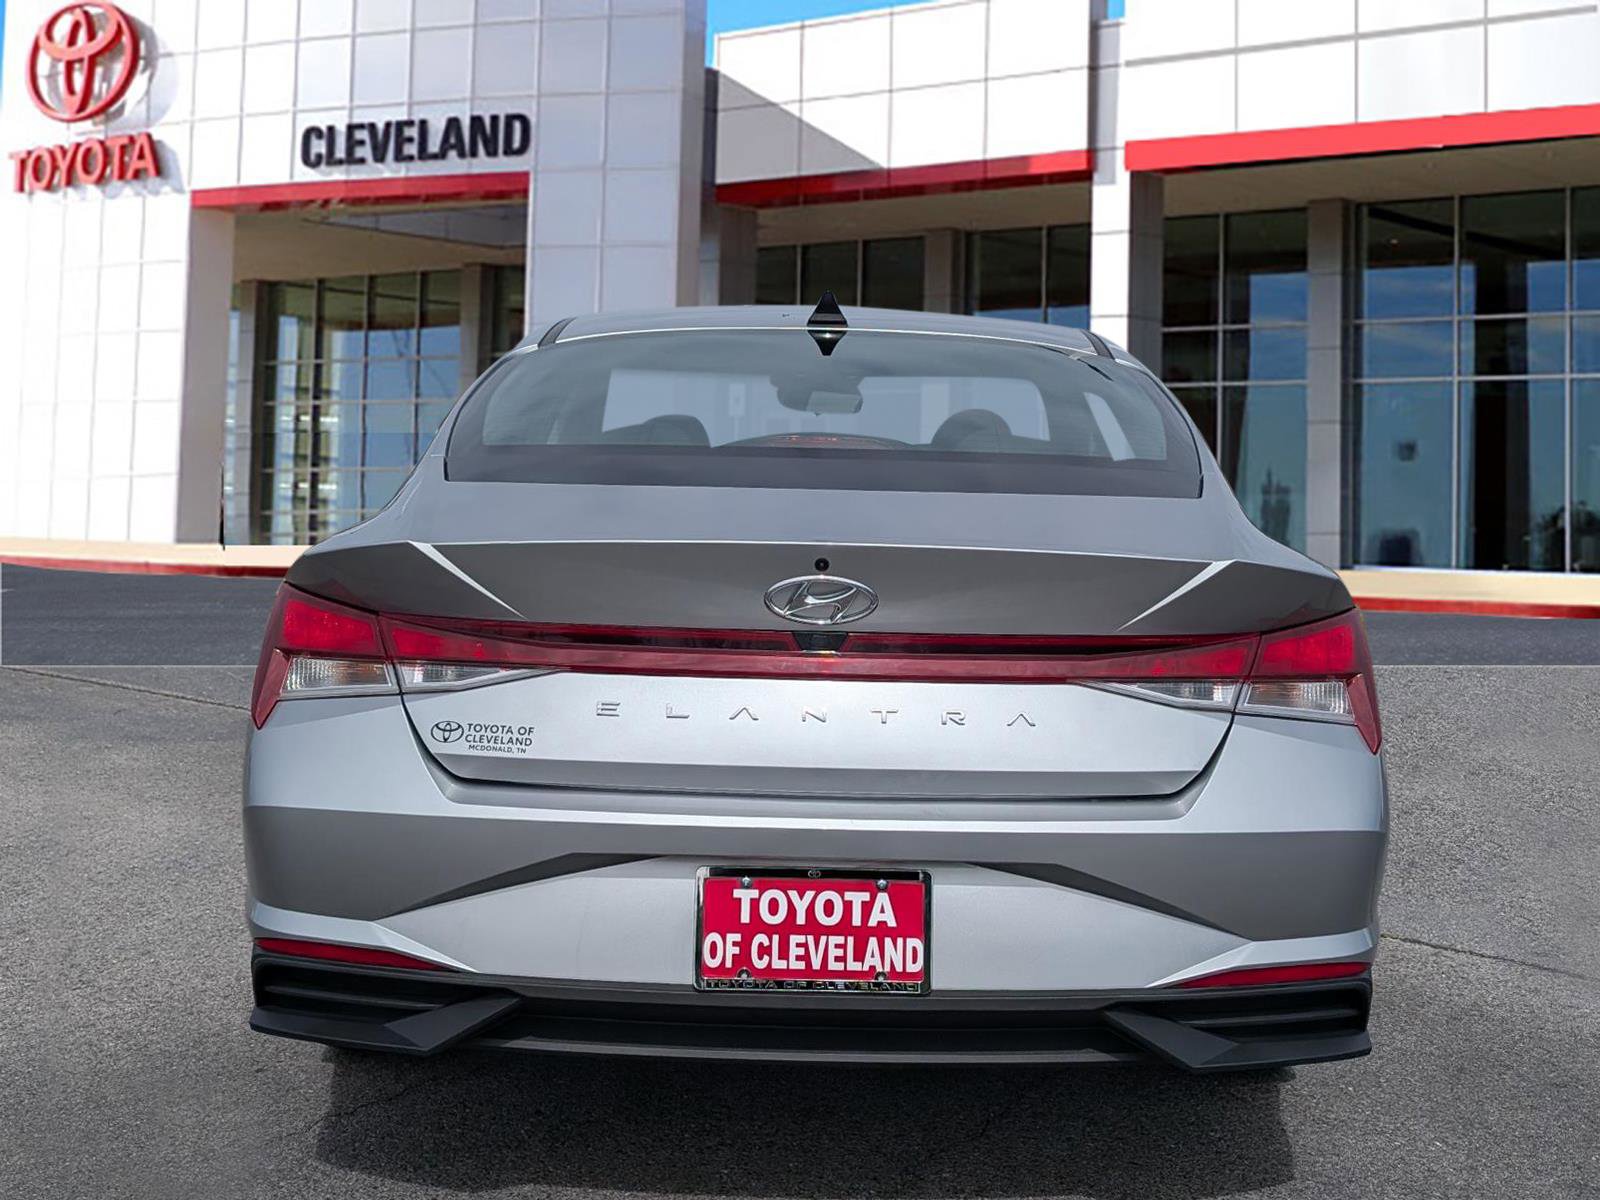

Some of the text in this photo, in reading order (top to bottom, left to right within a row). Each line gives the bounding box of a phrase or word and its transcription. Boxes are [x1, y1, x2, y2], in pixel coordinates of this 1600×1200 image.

[301, 113, 532, 170] CLEVELAND
[9, 132, 161, 193] TOYOTA
[467, 723, 535, 736] TOYOTA OF
[596, 701, 1036, 727] ELANTRA
[465, 734, 533, 747] CLEVELAND
[733, 889, 897, 927] TOYOTA
[703, 932, 924, 973] OF CLEVELAND
[707, 979, 919, 992] TOYOTA OF CLEVELAND
